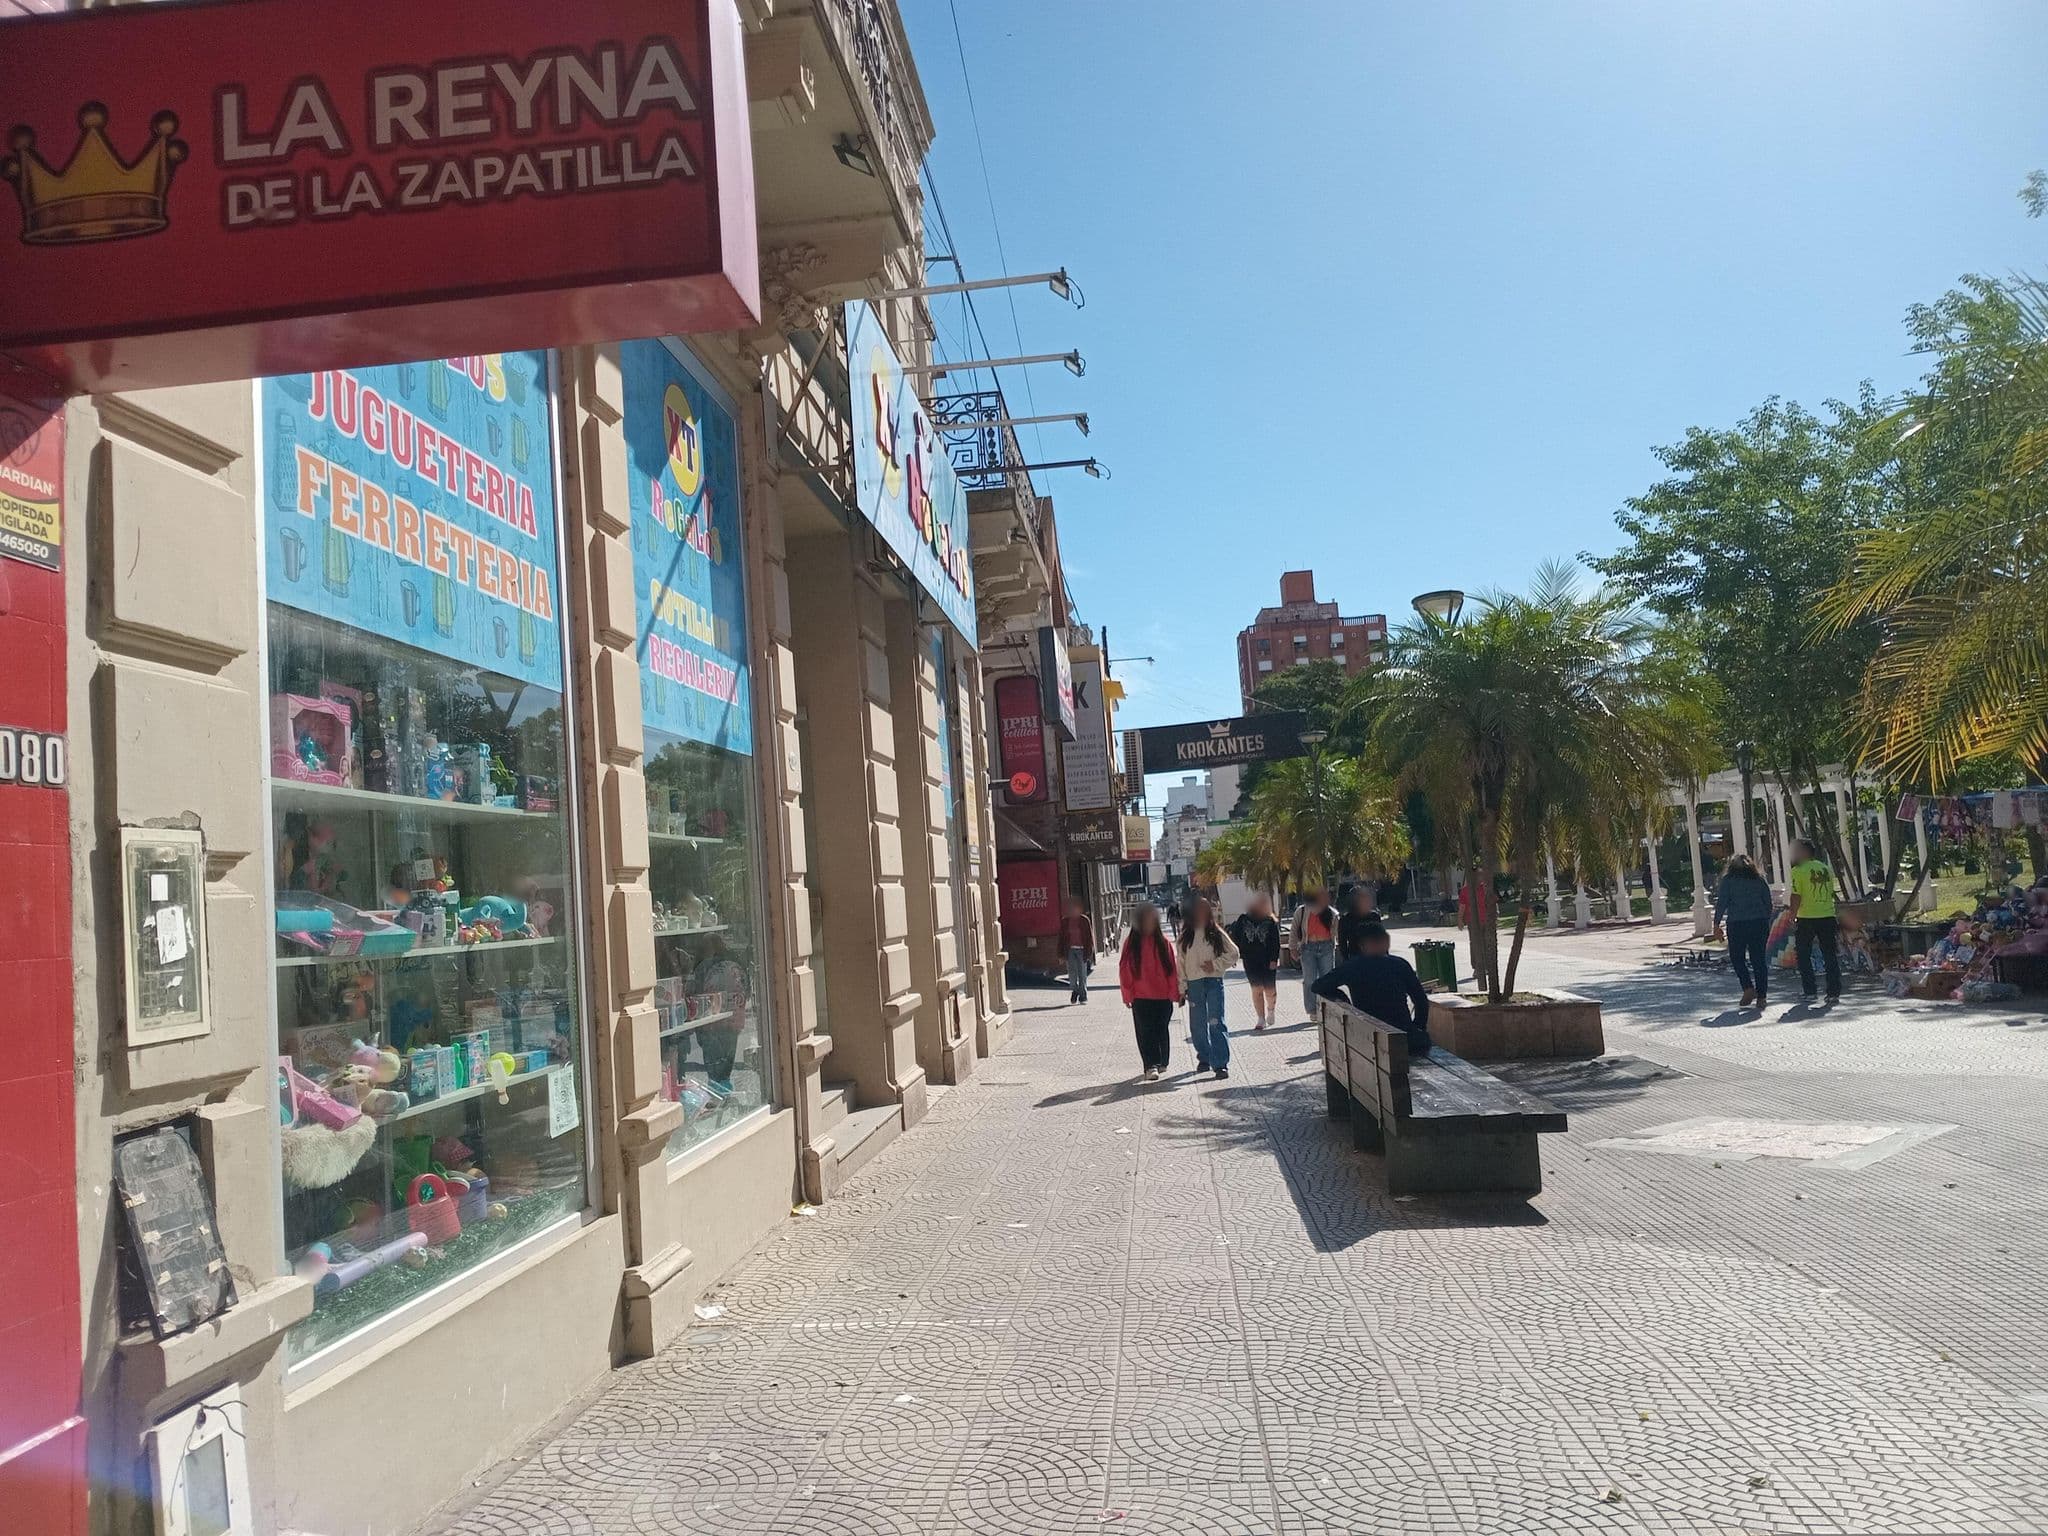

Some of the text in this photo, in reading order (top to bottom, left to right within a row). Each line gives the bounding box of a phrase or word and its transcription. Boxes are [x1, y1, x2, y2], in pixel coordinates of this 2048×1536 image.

[220, 45, 697, 162] LA REYNA
[227, 137, 696, 226] DE LA ZAPATILLA
[308, 370, 539, 540] JUGUETERIA
[665, 405, 700, 474] XT
[0, 464, 52, 496] ARDIAN
[295, 444, 553, 623] FERRETERIA
[648, 632, 739, 706] REGALERIA
[1002, 715, 1041, 732] IPRI
[1176, 734, 1265, 760] KROKANTES
[1070, 830, 1114, 842] KROKANTES
[1010, 886, 1048, 901] IPRI
